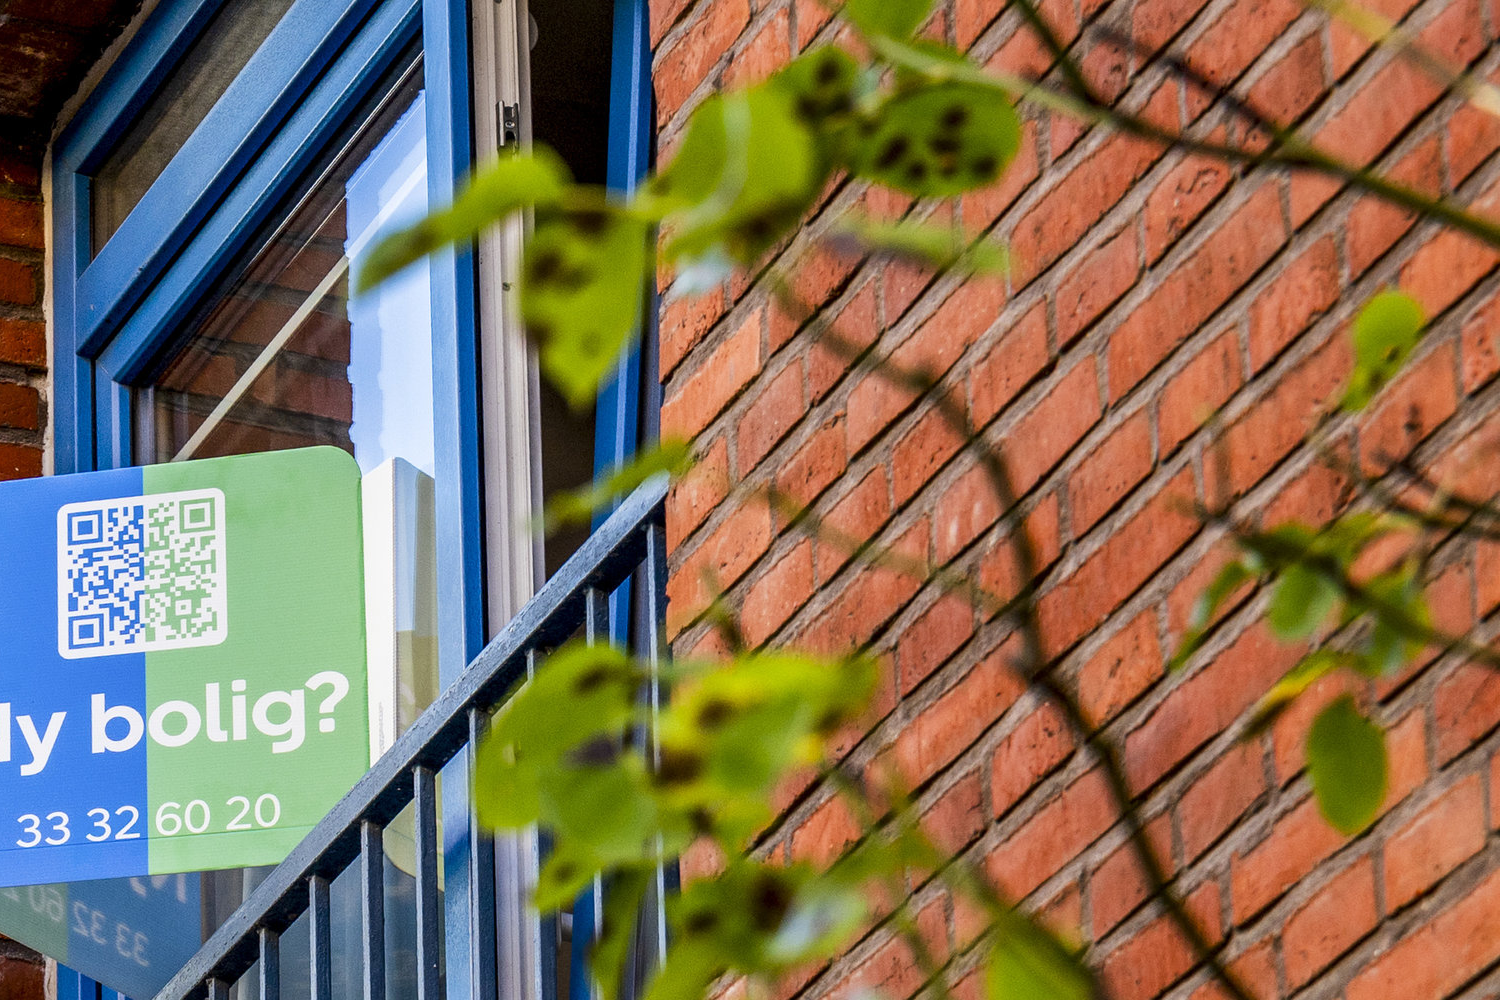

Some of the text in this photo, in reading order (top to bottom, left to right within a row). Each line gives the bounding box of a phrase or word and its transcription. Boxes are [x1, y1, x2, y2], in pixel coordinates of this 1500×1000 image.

[90, 671, 350, 755] bolig?
[15, 793, 281, 849] 33 32 60 20
